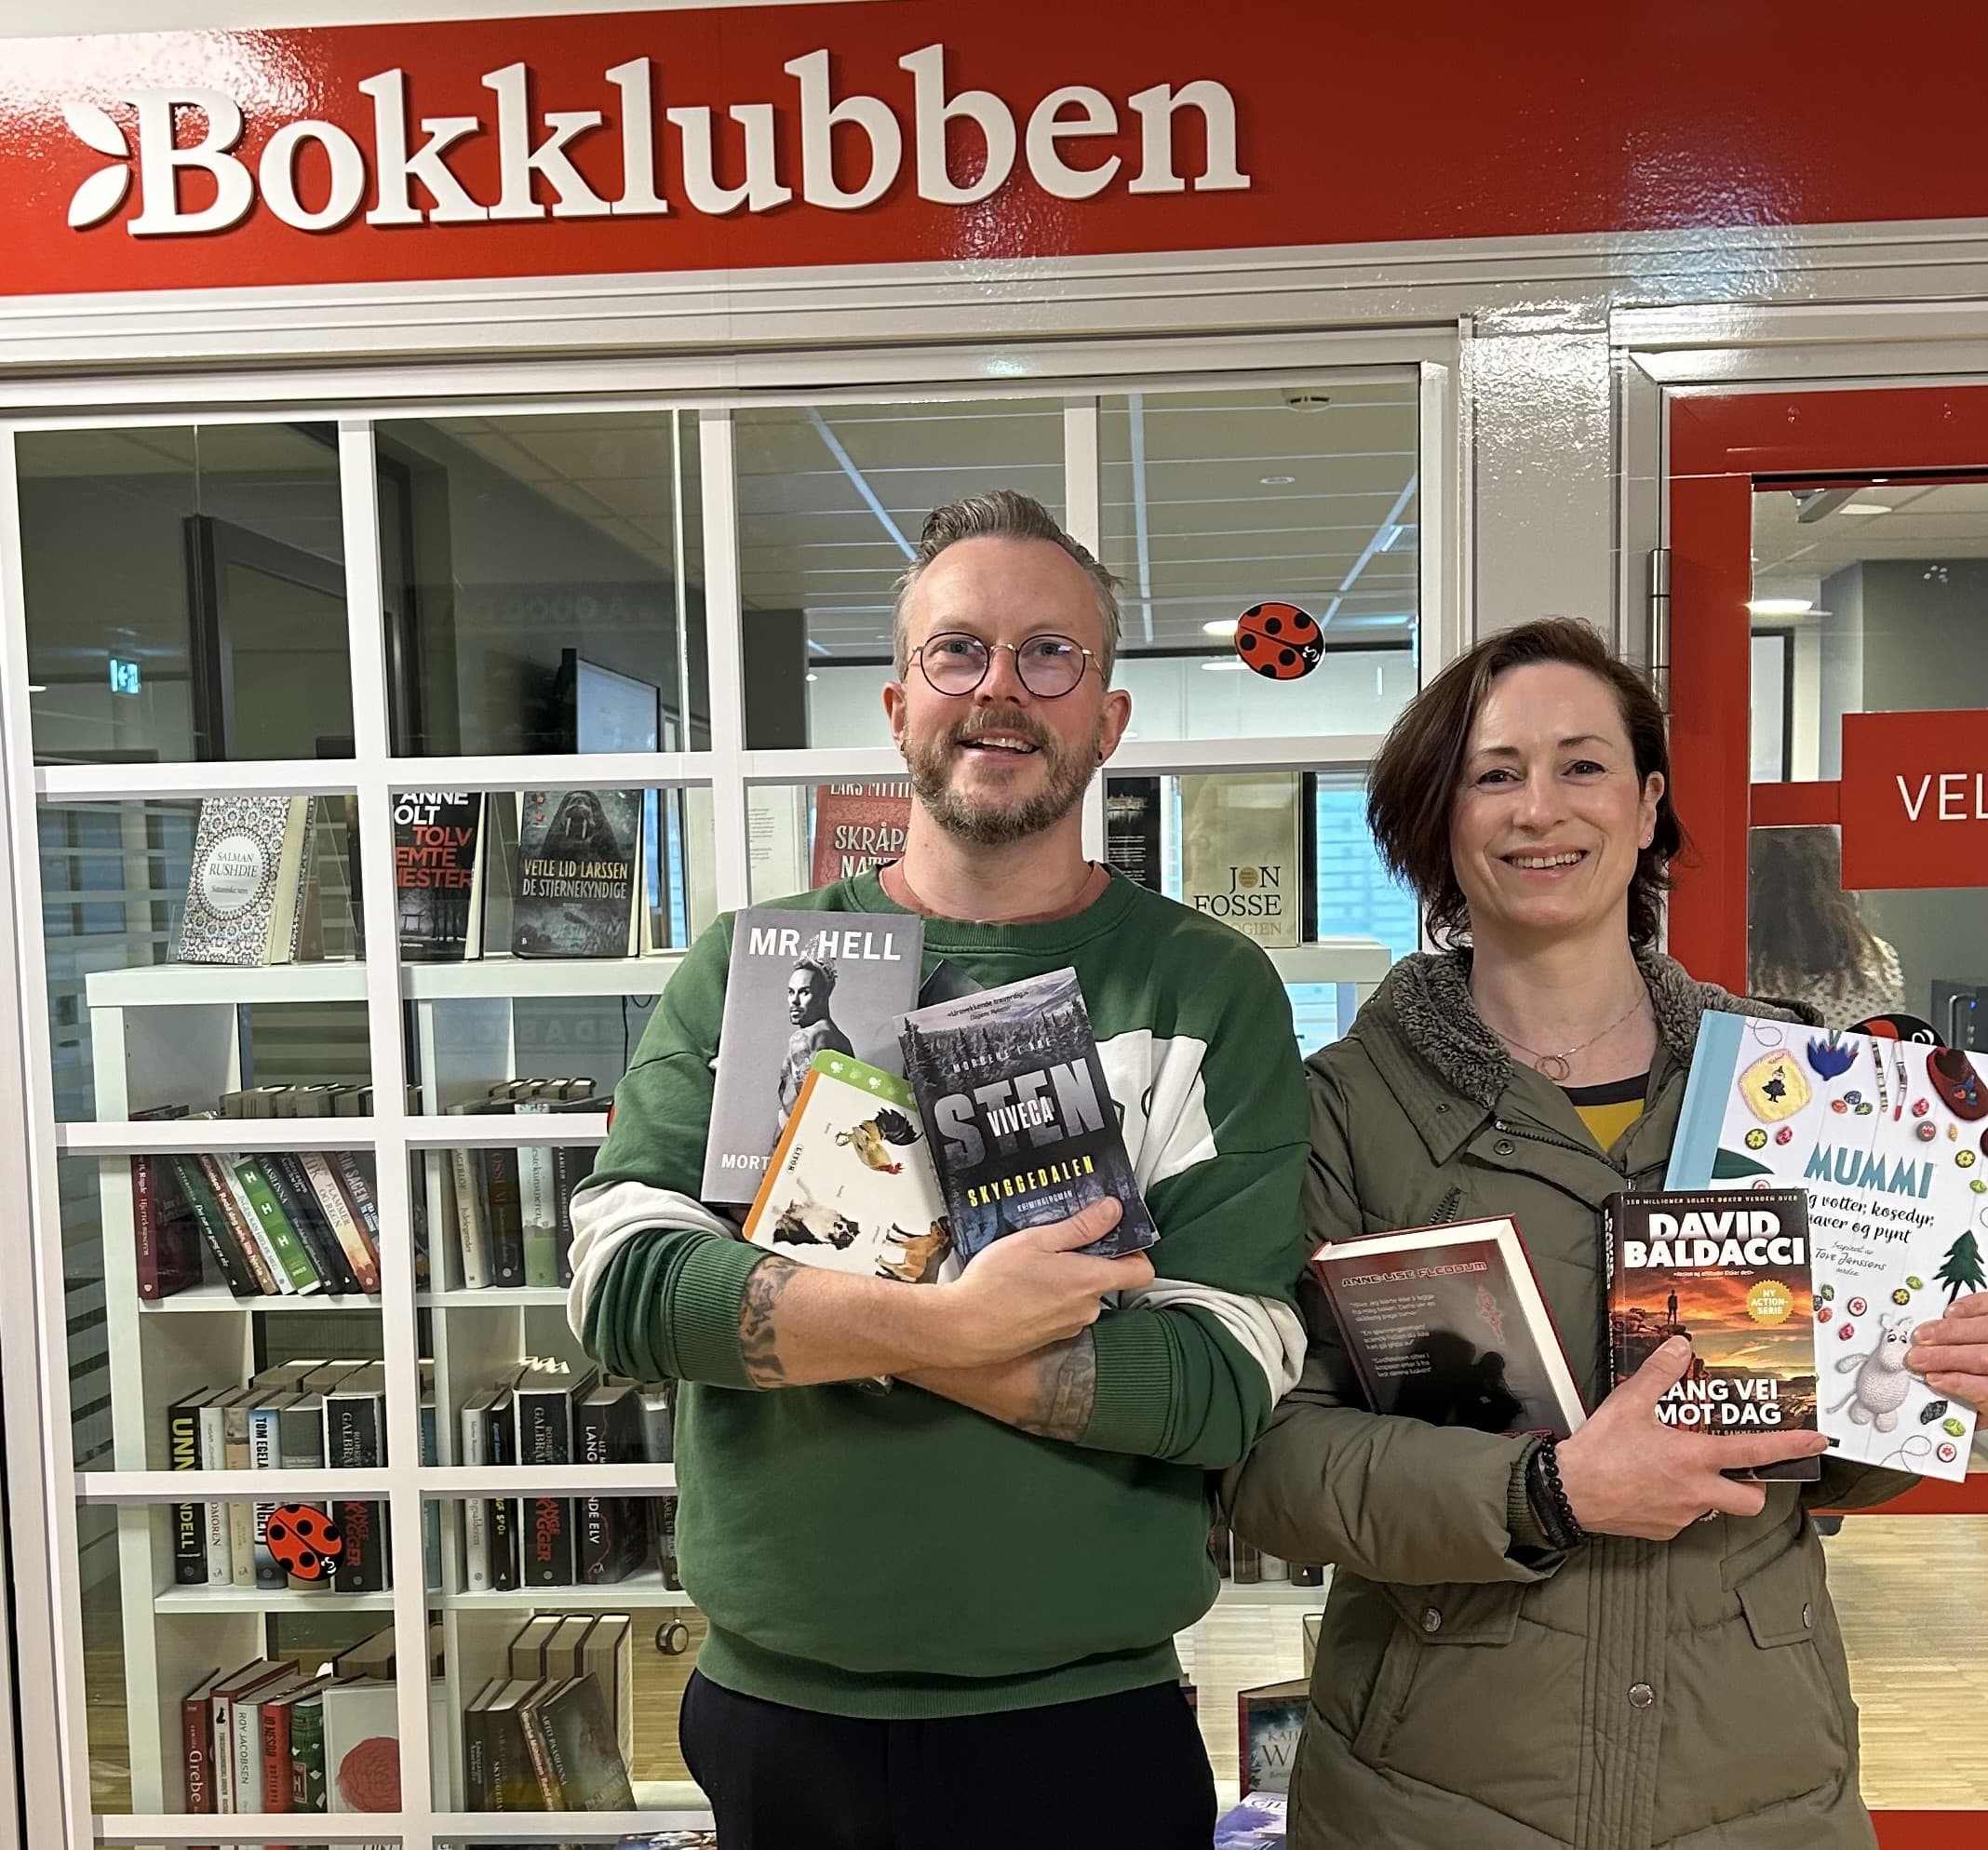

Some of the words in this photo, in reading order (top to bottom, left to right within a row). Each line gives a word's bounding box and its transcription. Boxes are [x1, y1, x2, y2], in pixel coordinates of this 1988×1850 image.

[128, 44, 1251, 236] Bokklubben
[399, 792, 468, 805] ANNE
[394, 805, 440, 825] OLT
[412, 826, 474, 847] TOLV
[217, 851, 253, 863] SALMAN
[396, 846, 457, 867] EMTE
[209, 864, 258, 878] RUSHDIE
[524, 859, 556, 877] VETLE
[558, 861, 576, 878] LID
[581, 862, 628, 879] LARSSEN
[523, 878, 536, 896] DE
[539, 878, 627, 899] STJERNEKYNDIGE
[1194, 894, 1283, 917] FOSSE
[817, 931, 901, 960] HELL
[934, 1058, 1105, 1171] STEN
[987, 1095, 1054, 1137] VIVECA
[721, 1153, 771, 1170] MORT
[1803, 1141, 1934, 1199] MUMMI
[967, 1155, 1095, 1207] SKYGGEDALEN
[1648, 1211, 1780, 1242] DAVID
[1809, 1213, 1848, 1228] aver
[1851, 1222, 1871, 1239] og
[1874, 1227, 1912, 1244] pynt
[1624, 1237, 1805, 1268] BALDACCI
[1816, 1247, 1836, 1261] Tove
[1838, 1252, 1887, 1270] Janssons
[1762, 1289, 1777, 1298] NY
[1733, 1379, 1778, 1401] VEI
[1655, 1403, 1714, 1425] MOT
[1721, 1403, 1781, 1425] DAG
[255, 1417, 267, 1439] TOM
[172, 1417, 195, 1470] UNN
[256, 1441, 269, 1469] EGELA
[588, 1496, 599, 1519] NDE
[179, 1503, 194, 1549] NDELL
[208, 1503, 222, 1547] DMOREN
[343, 1503, 362, 1567] KYGGER
[536, 1498, 552, 1562] KYGGER
[588, 1523, 600, 1545] ELV
[238, 1712, 248, 1732] ROY
[239, 1733, 249, 1785] JACOBSEN
[188, 1750, 205, 1803] Grebe
